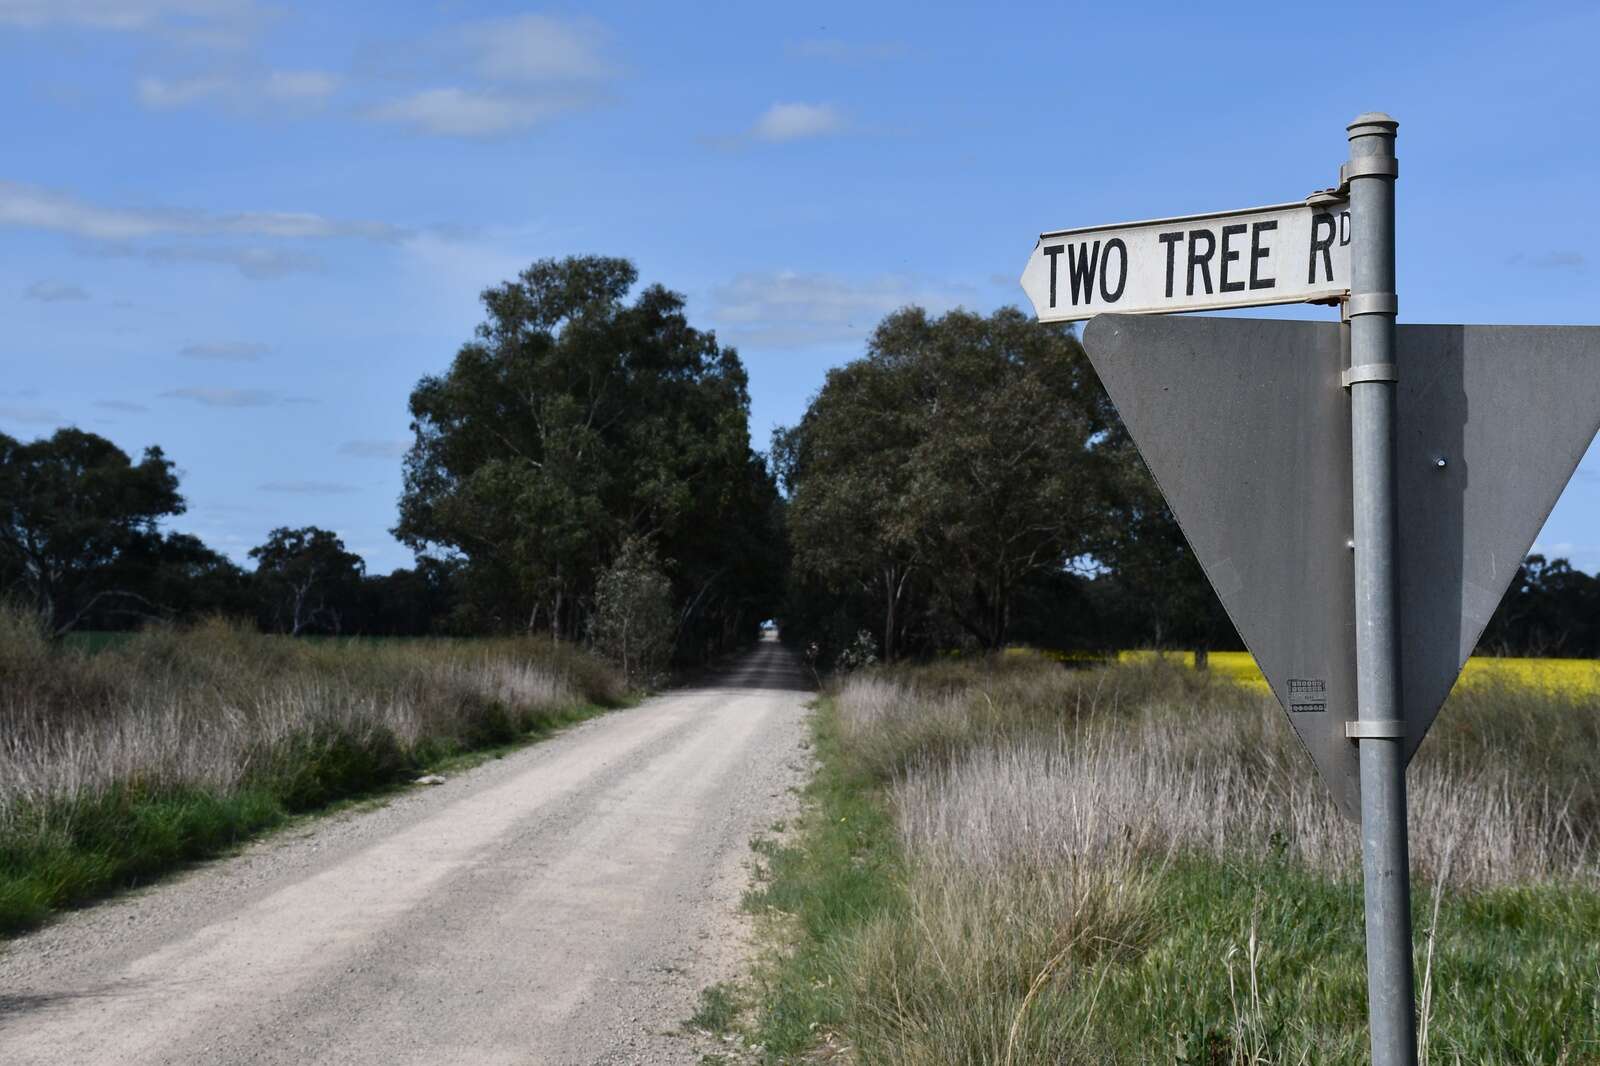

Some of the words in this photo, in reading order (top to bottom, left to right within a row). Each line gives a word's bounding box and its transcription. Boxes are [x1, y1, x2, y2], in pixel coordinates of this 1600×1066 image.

[1043, 238, 1128, 308] TWO
[1159, 220, 1278, 298] TREE
[1308, 212, 1351, 284] RD
